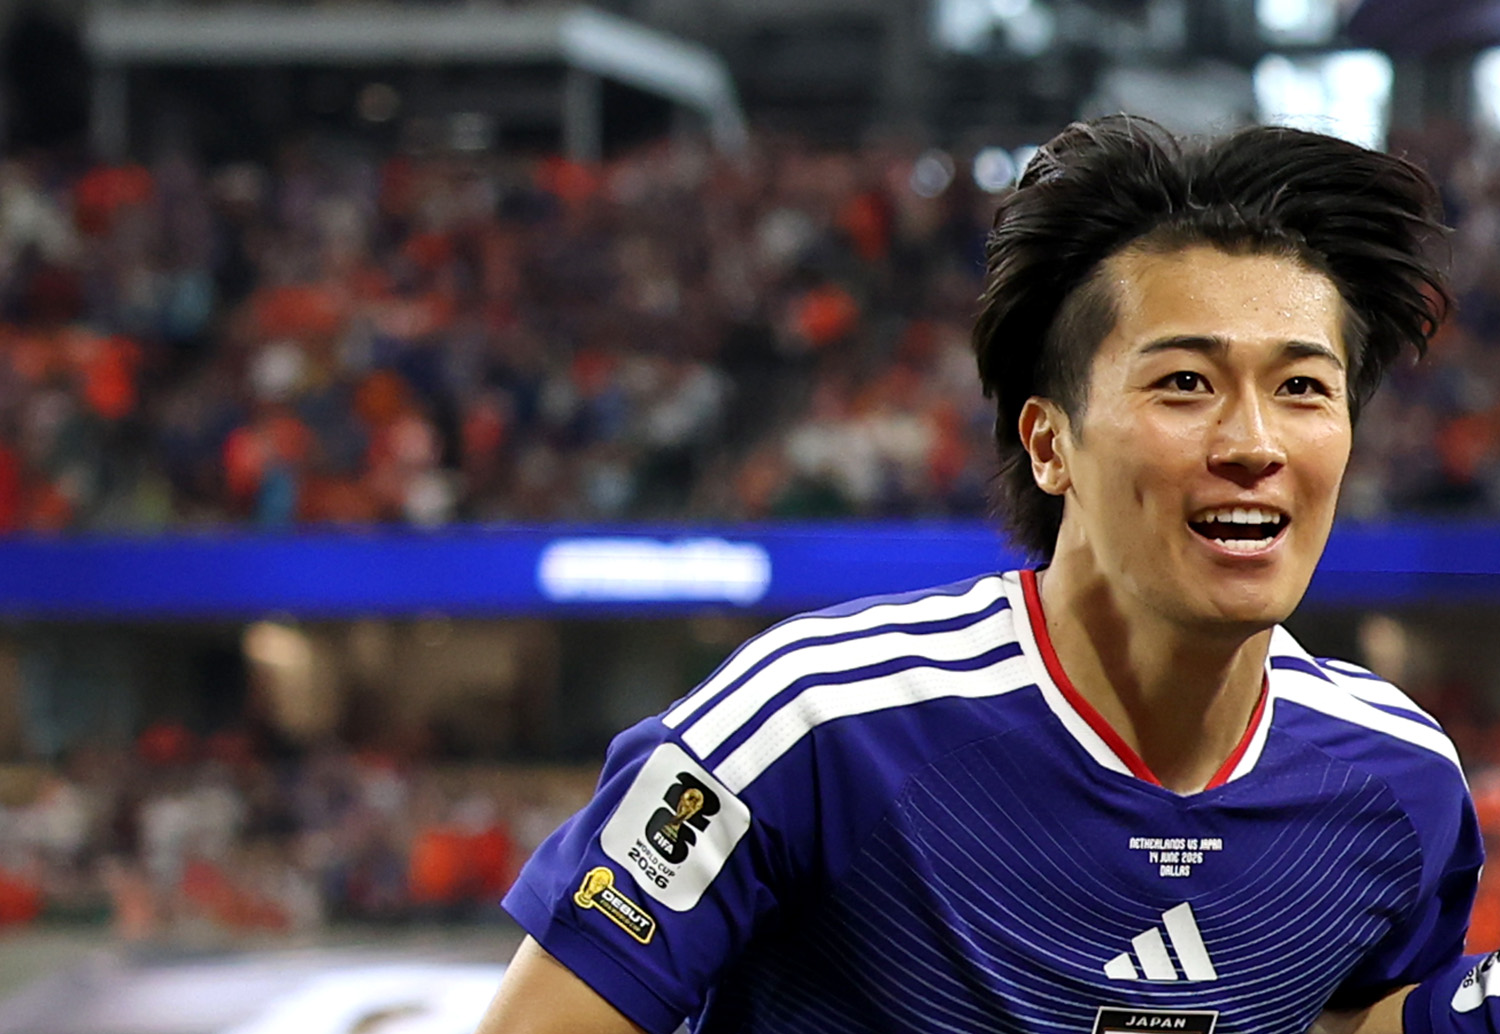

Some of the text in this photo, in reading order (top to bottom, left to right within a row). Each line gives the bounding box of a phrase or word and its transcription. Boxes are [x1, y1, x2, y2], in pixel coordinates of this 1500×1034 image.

[653, 831, 674, 855] FIFA
[1129, 837, 1185, 850] NETHERLANDS
[1199, 838, 1222, 850] JAPAN
[636, 838, 676, 877] WORLD CUP
[1149, 851, 1203, 864] 14 JUNE 2026
[628, 847, 669, 889] 2026
[1160, 865, 1190, 877] DALLAS
[601, 889, 650, 928] DEBUT
[1125, 1016, 1186, 1028] JAPAN
